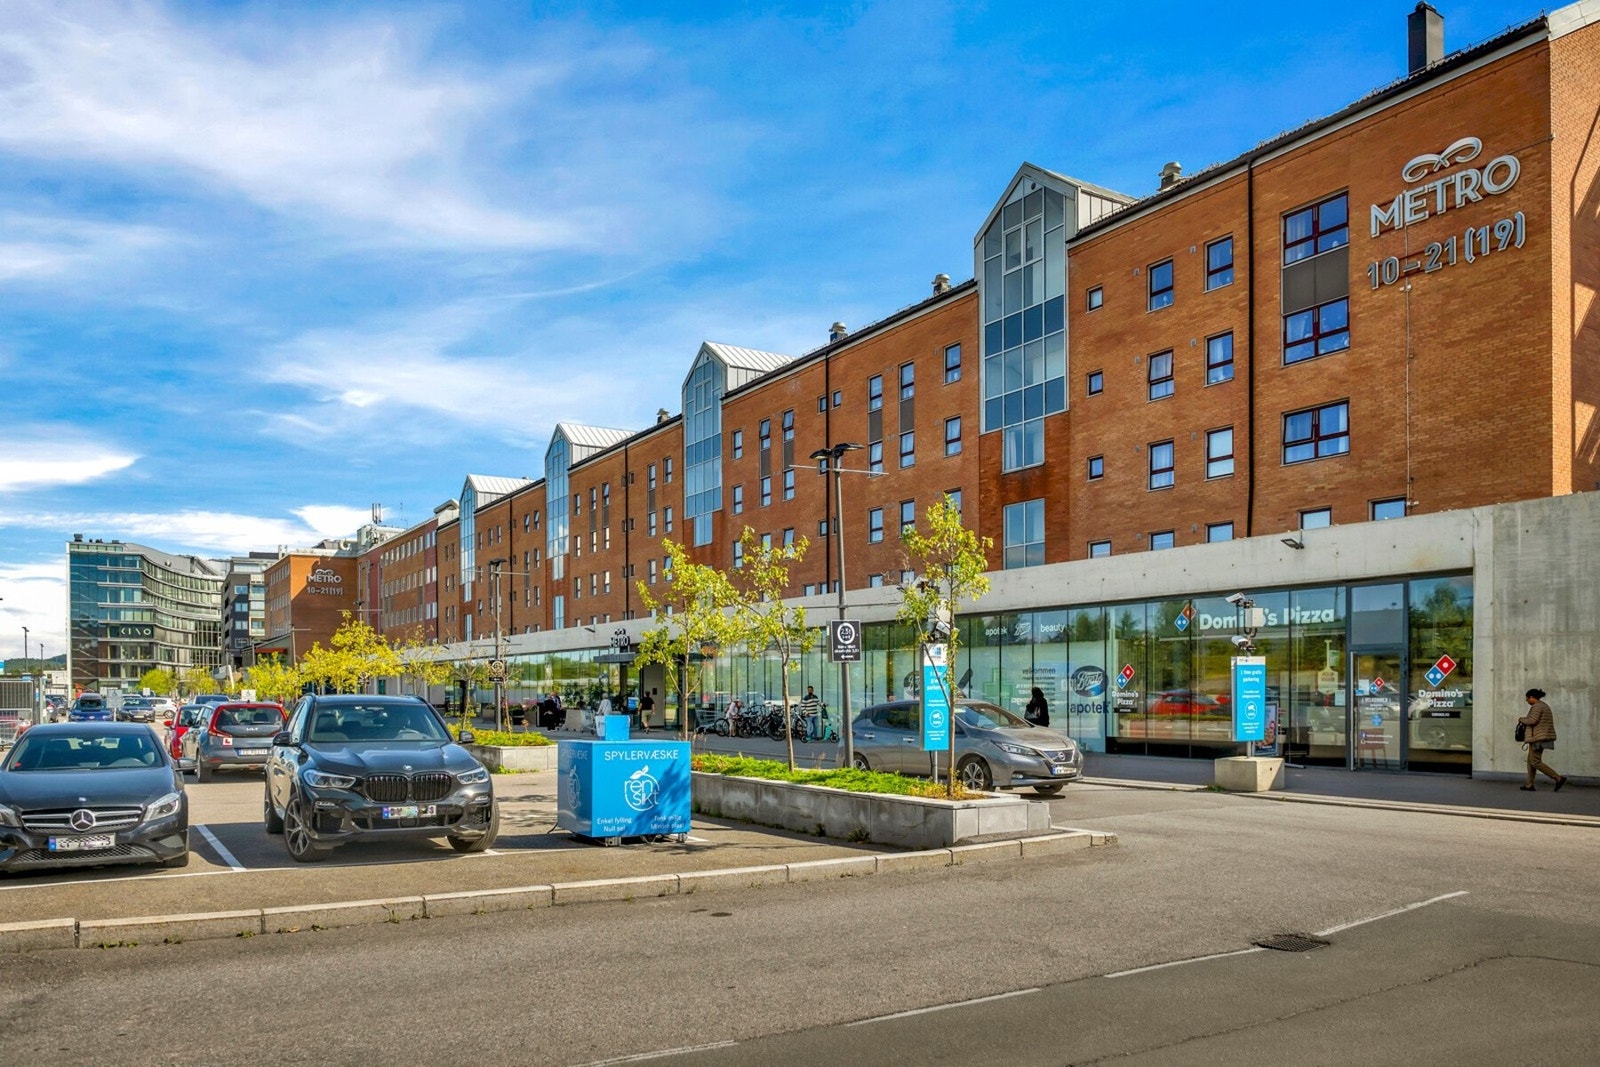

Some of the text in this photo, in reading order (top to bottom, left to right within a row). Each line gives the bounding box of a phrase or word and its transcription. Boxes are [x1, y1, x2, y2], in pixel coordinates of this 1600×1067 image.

[1370, 154, 1521, 238] METRO
[307, 573, 342, 583] METRO
[1199, 605, 1335, 630] Domi's Pizza
[985, 626, 1008, 636] apotek
[1040, 623, 1065, 633] beauty
[1111, 690, 1139, 698] Domino's
[1418, 689, 1463, 698] Domino's
[1070, 701, 1110, 714] apotek
[1427, 699, 1454, 707] Pizza
[604, 749, 680, 760] SPYLERVÆSKE
